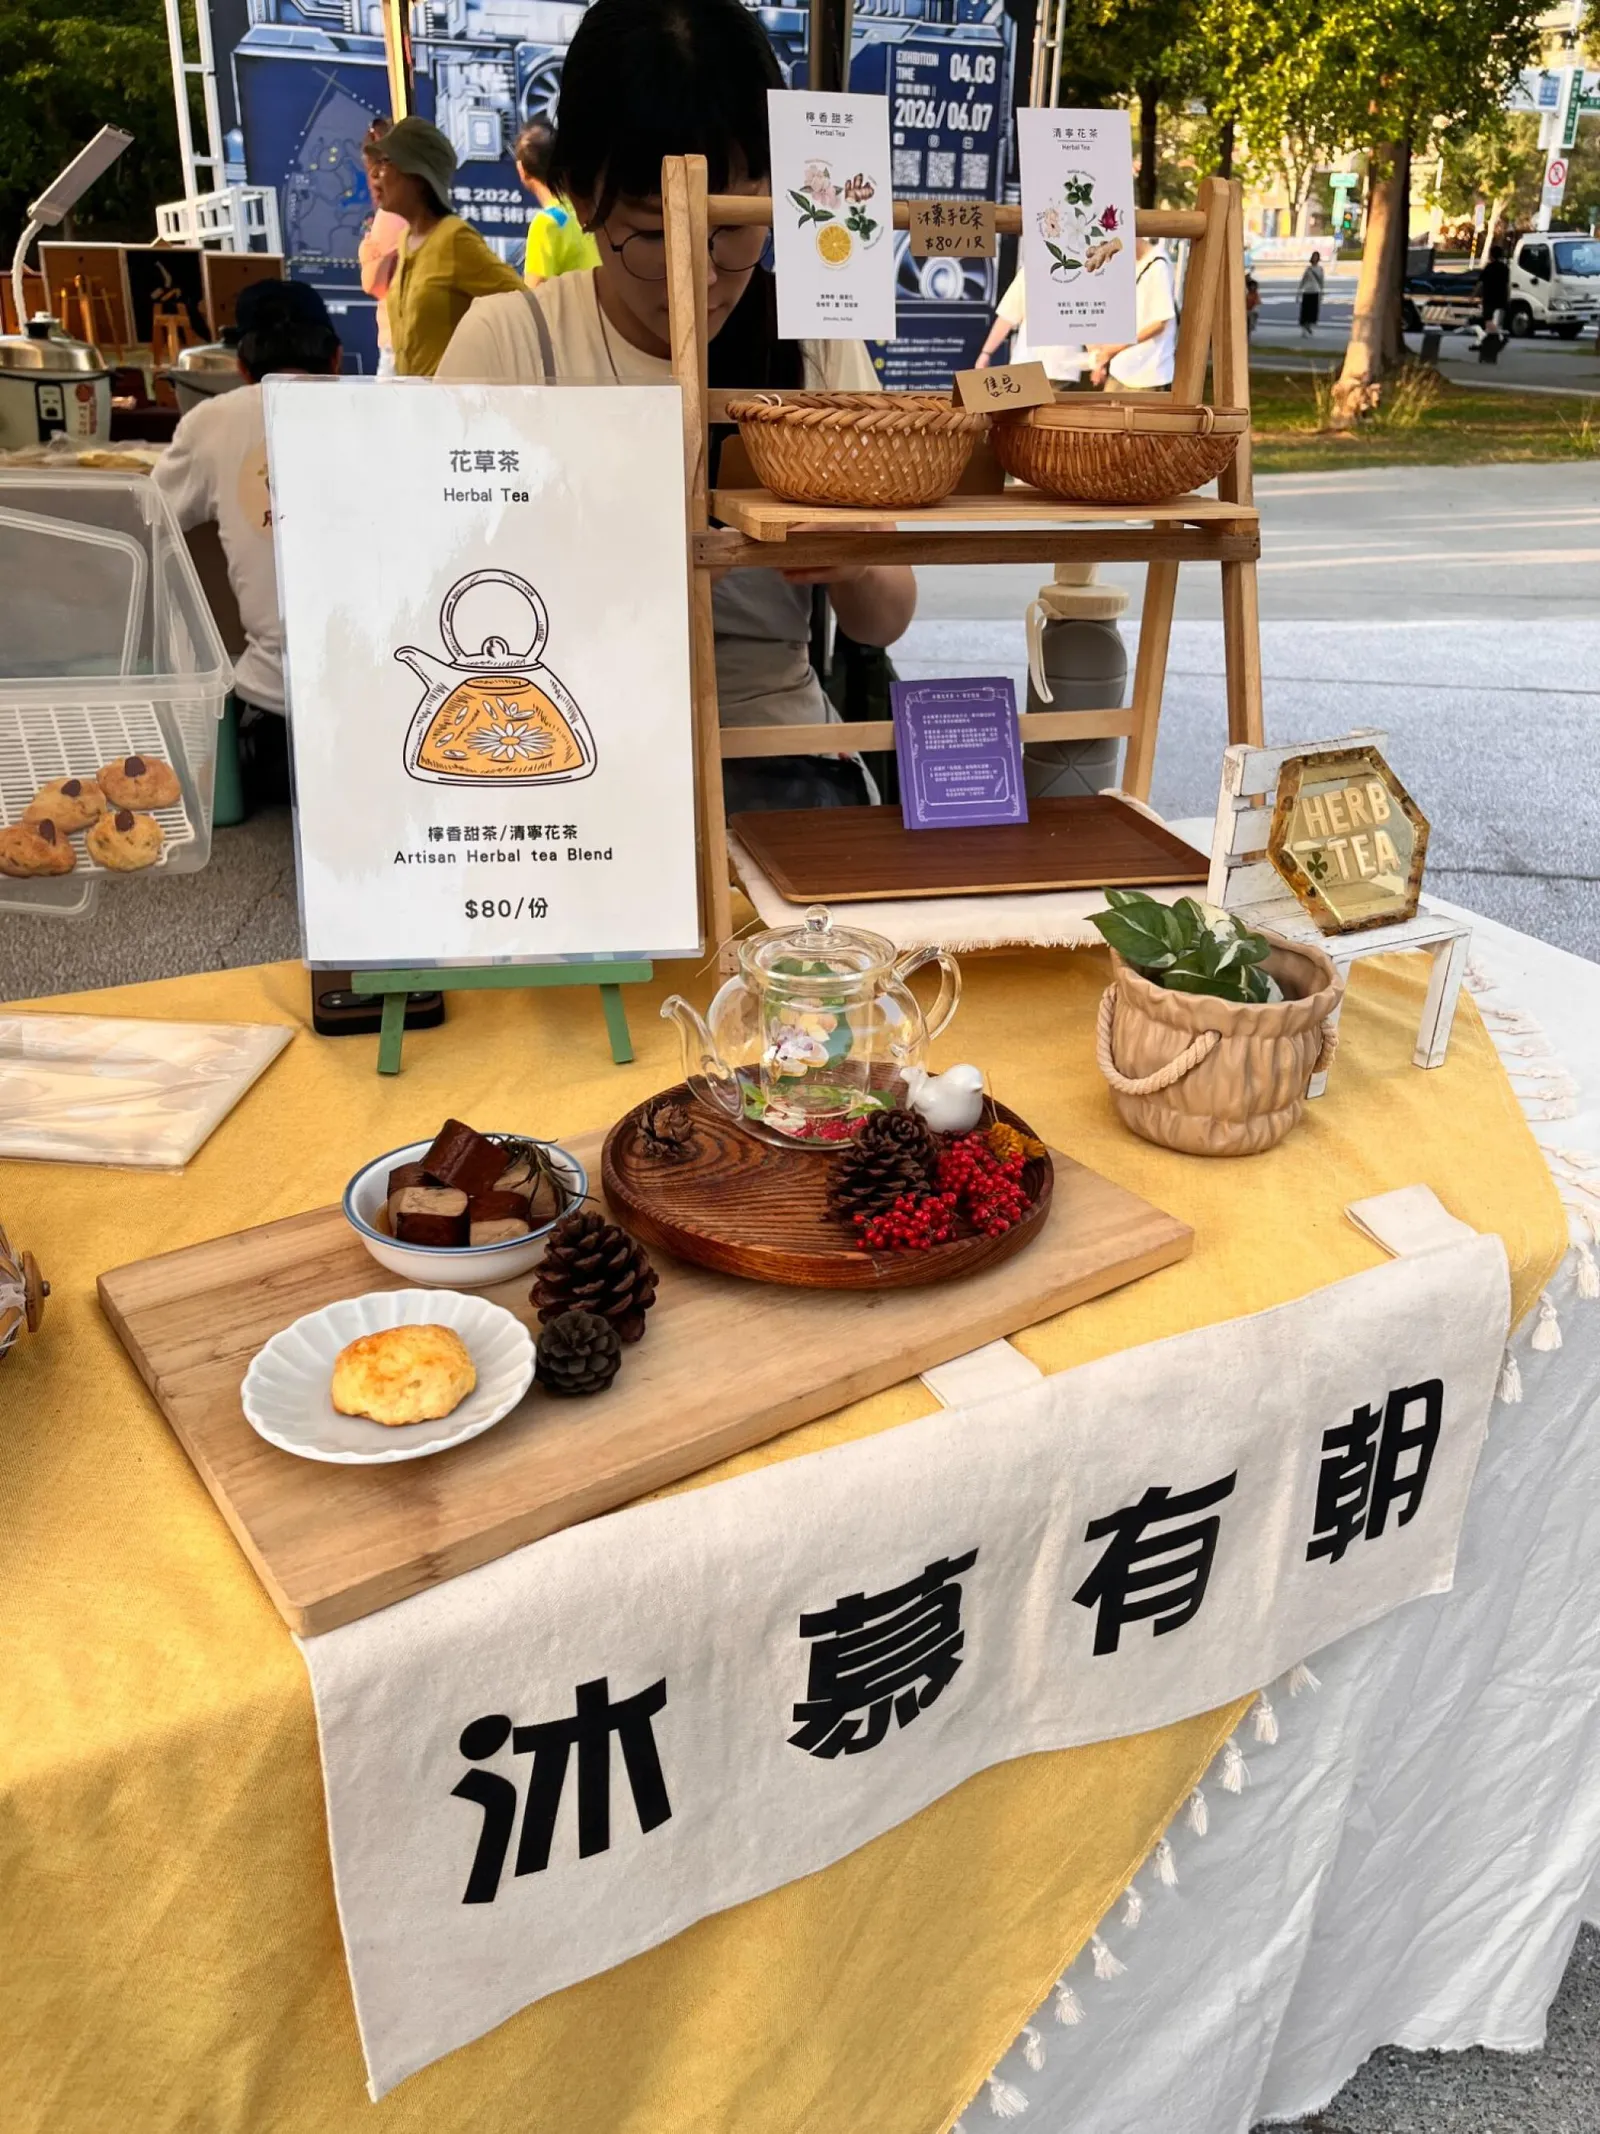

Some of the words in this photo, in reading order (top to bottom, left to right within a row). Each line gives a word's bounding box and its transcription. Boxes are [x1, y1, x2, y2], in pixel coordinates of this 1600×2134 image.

[896, 67, 915, 80] TIME
[949, 53, 996, 84] 04.03
[815, 129, 834, 137] Herbal
[447, 187, 522, 203] 電2026
[449, 449, 520, 473] 花草茶
[443, 487, 492, 502] Herbal
[500, 488, 530, 502] Tea
[1303, 782, 1391, 838] HERB
[393, 850, 457, 864] Artisan
[467, 849, 521, 863] Herbal
[531, 850, 558, 862] tea
[567, 847, 613, 861] Blend
[1327, 829, 1401, 880] TEA
[464, 897, 549, 920] $80/份
[450, 1378, 1444, 1905] 沐慕有朝
